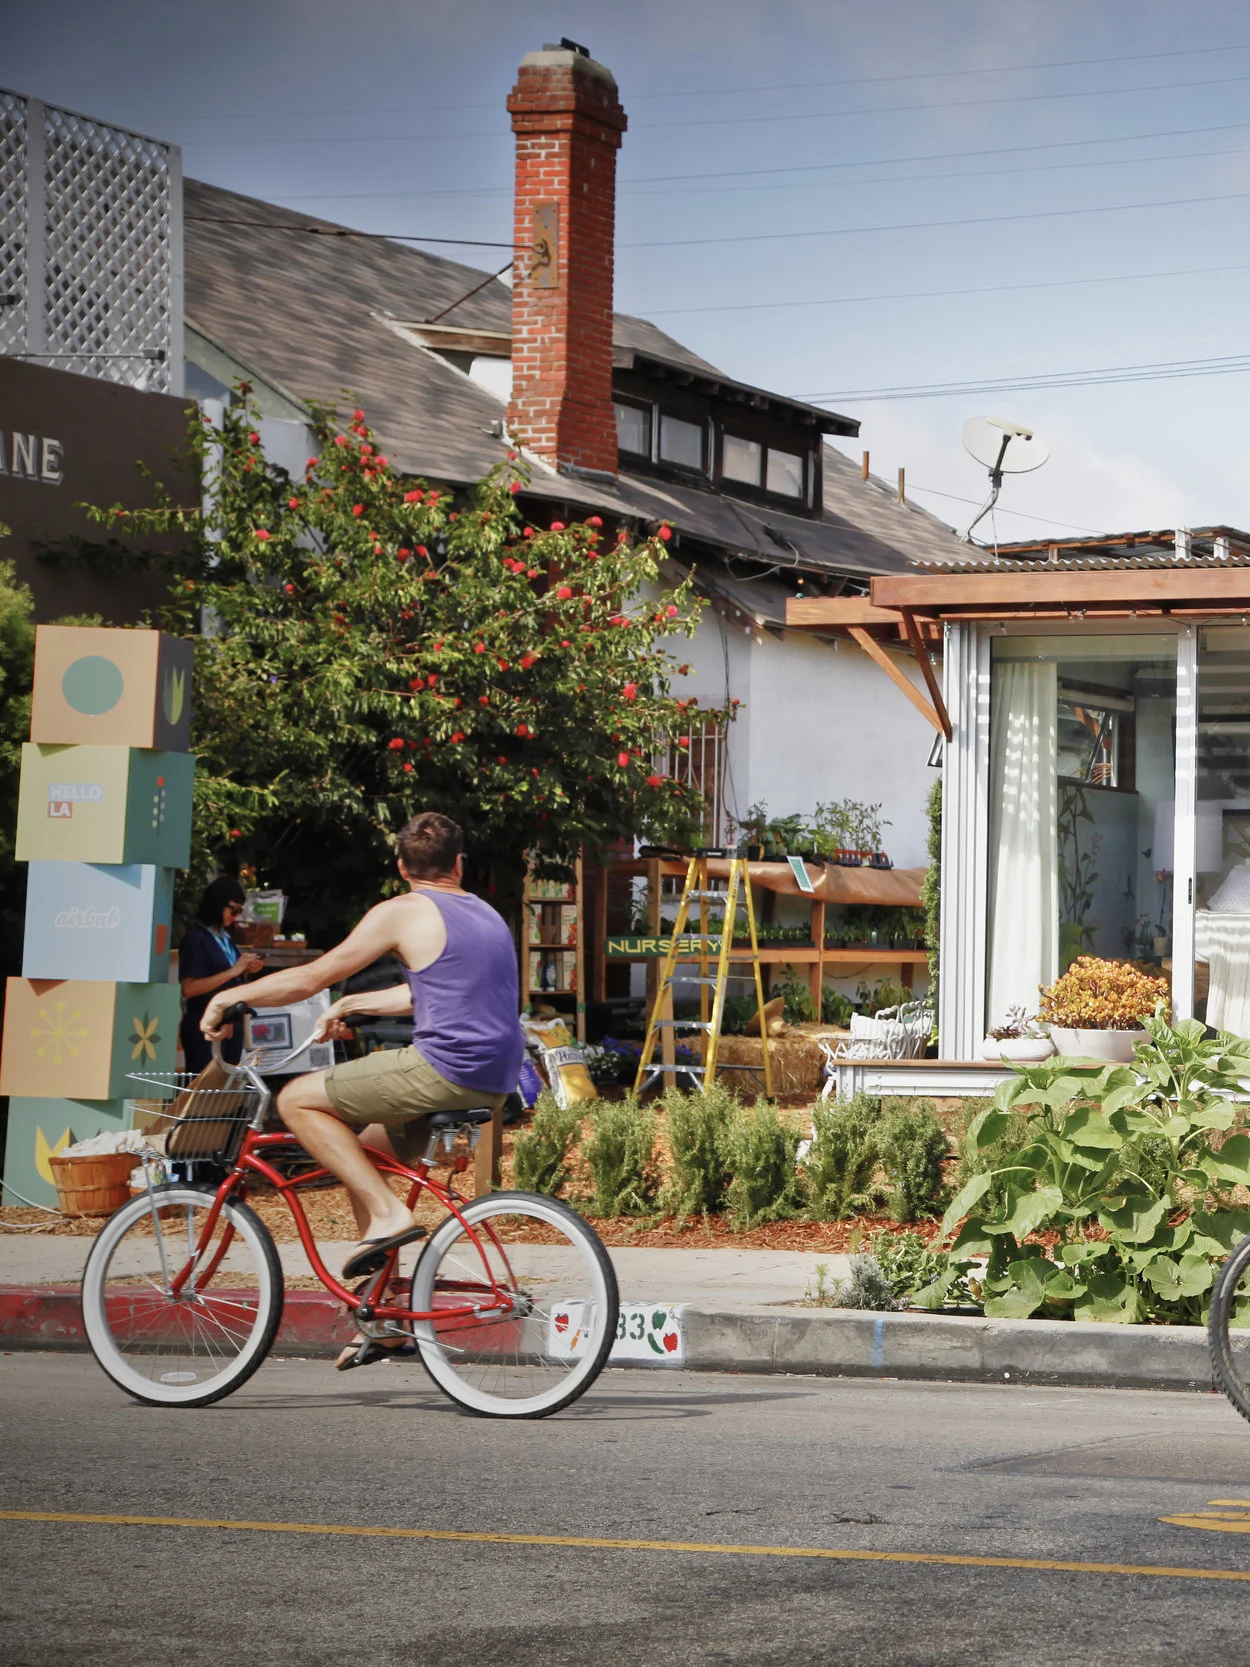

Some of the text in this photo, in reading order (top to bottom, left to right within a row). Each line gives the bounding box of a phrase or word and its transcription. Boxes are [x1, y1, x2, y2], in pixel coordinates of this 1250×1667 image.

[50, 785, 102, 800] HELLO
[49, 802, 71, 817] LA
[55, 905, 121, 929] airbnb
[608, 939, 722, 953] NURSERY
